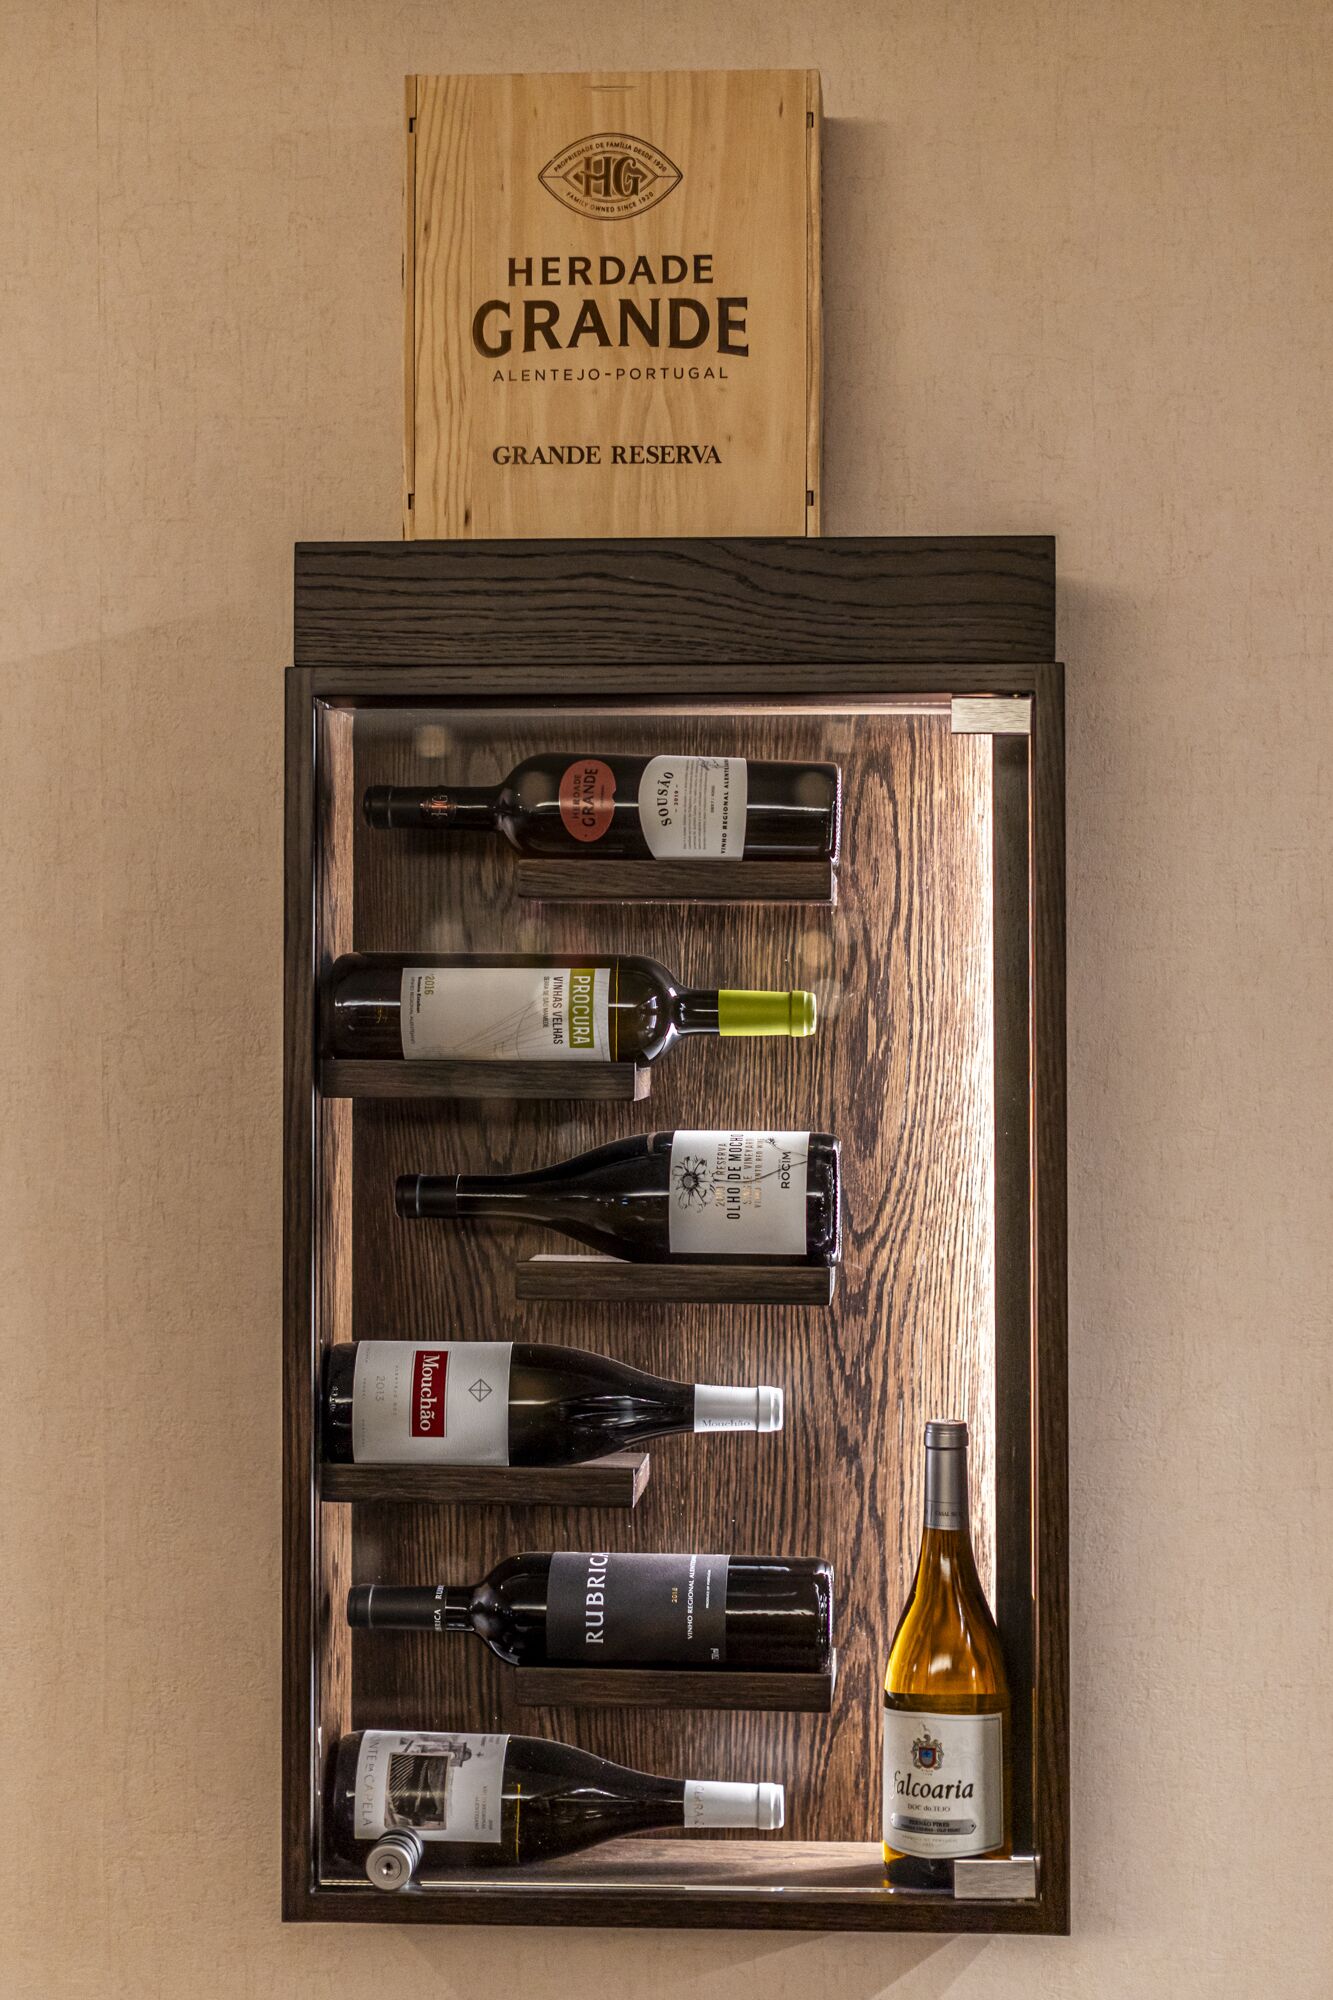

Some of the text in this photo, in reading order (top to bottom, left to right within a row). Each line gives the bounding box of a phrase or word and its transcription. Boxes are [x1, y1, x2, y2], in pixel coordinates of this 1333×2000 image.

[554, 144, 593, 172] PROPRIEDADE
[633, 146, 652, 160] DESDE
[654, 159, 668, 172] 1920
[581, 156, 641, 198] HG
[566, 192, 654, 213] FAMILY OWNED SINCE 1920
[507, 254, 713, 287] HERDADE
[472, 297, 749, 358] GRANDE
[493, 366, 728, 382] ALENTEJO-PORTUGAL
[492, 445, 722, 465] GRANDE RESERVA
[571, 774, 582, 819] HERDADE
[581, 768, 598, 827] GRANDE
[656, 772, 674, 826] SOUSÃO
[424, 975, 435, 995] 2016
[552, 976, 563, 1045] VINHAS VELHAS
[572, 975, 591, 1044] PROCURA
[715, 1143, 727, 1175] RESERVA
[744, 1138, 753, 1169] VINEYARD
[781, 1152, 791, 1189] ROCIM
[726, 1134, 744, 1219] OLHO DE MOCHO
[375, 1376, 385, 1402] 2013
[419, 1354, 440, 1431] Mouchão
[586, 1552, 609, 1644] RUBRICA
[362, 1774, 375, 1826] CAPELA
